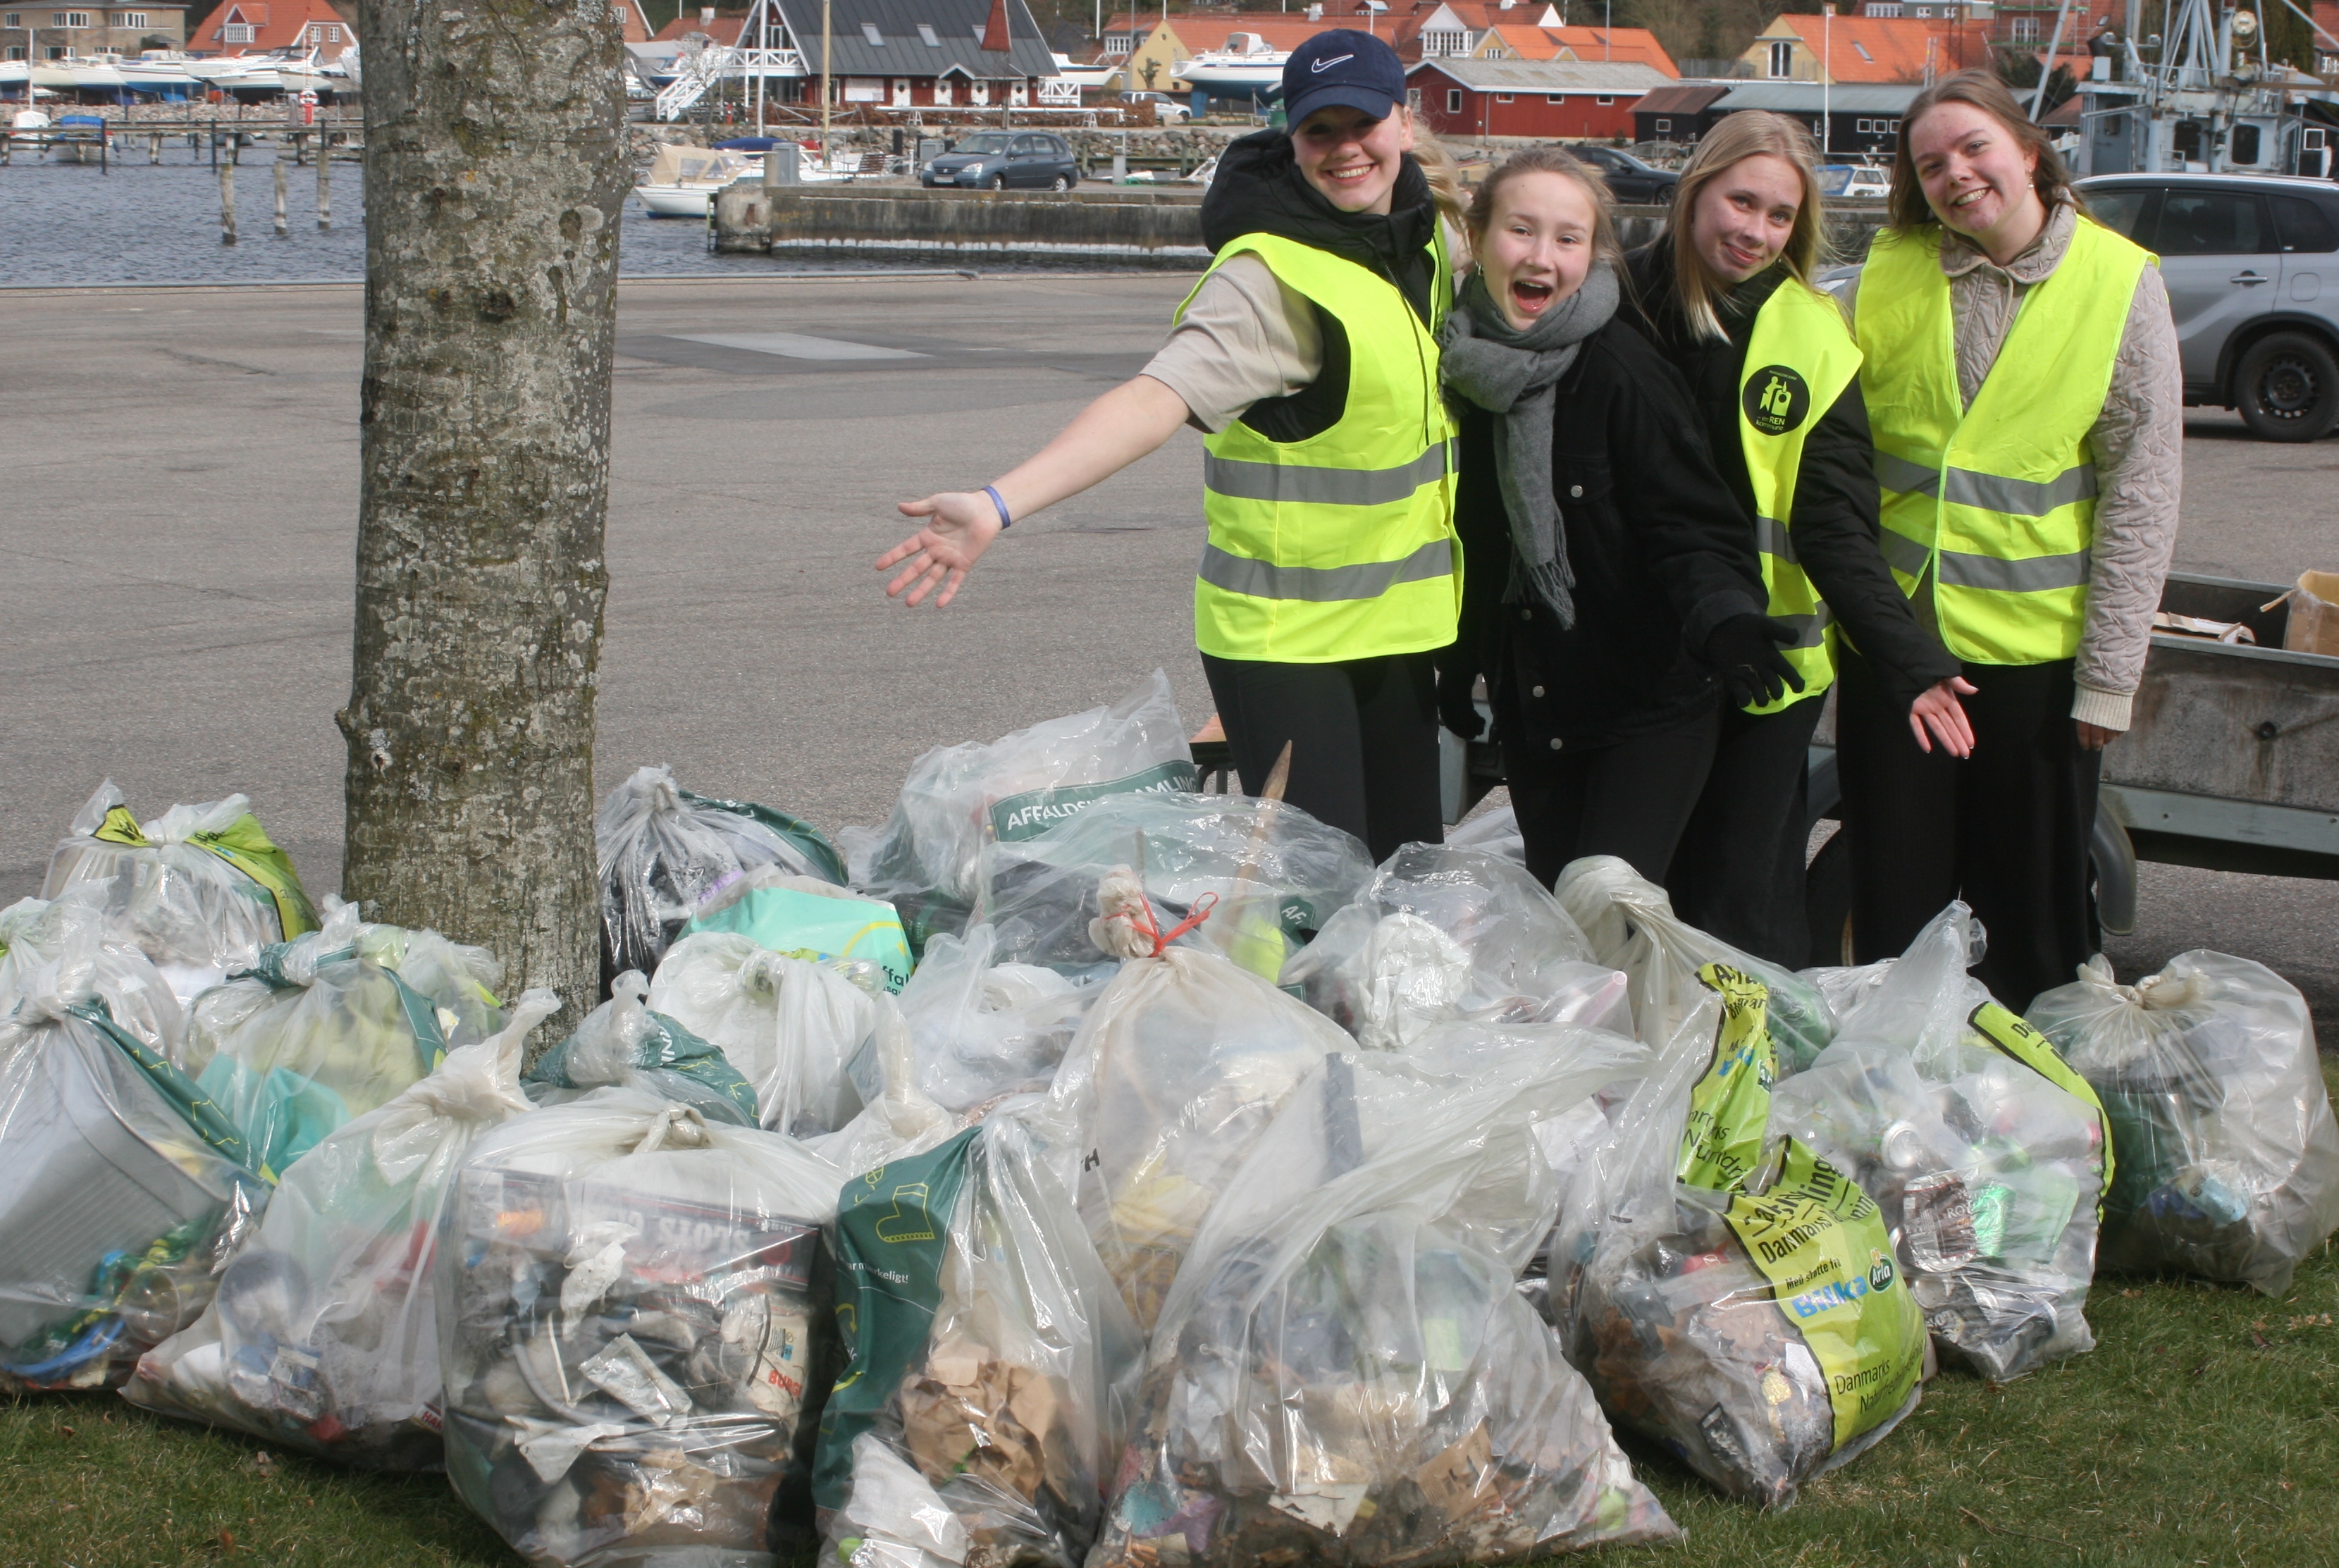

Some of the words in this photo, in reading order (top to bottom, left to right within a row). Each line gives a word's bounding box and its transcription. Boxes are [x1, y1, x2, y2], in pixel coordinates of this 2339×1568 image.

[1770, 416, 1785, 425] REN
[1784, 1273, 1804, 1290] Med
[1806, 1264, 1829, 1282] støtte
[1829, 1258, 1842, 1269] fra
[1872, 1264, 1891, 1285] Arla
[1791, 1276, 1868, 1319] Bilka
[1834, 1359, 1890, 1395] Danmarks
